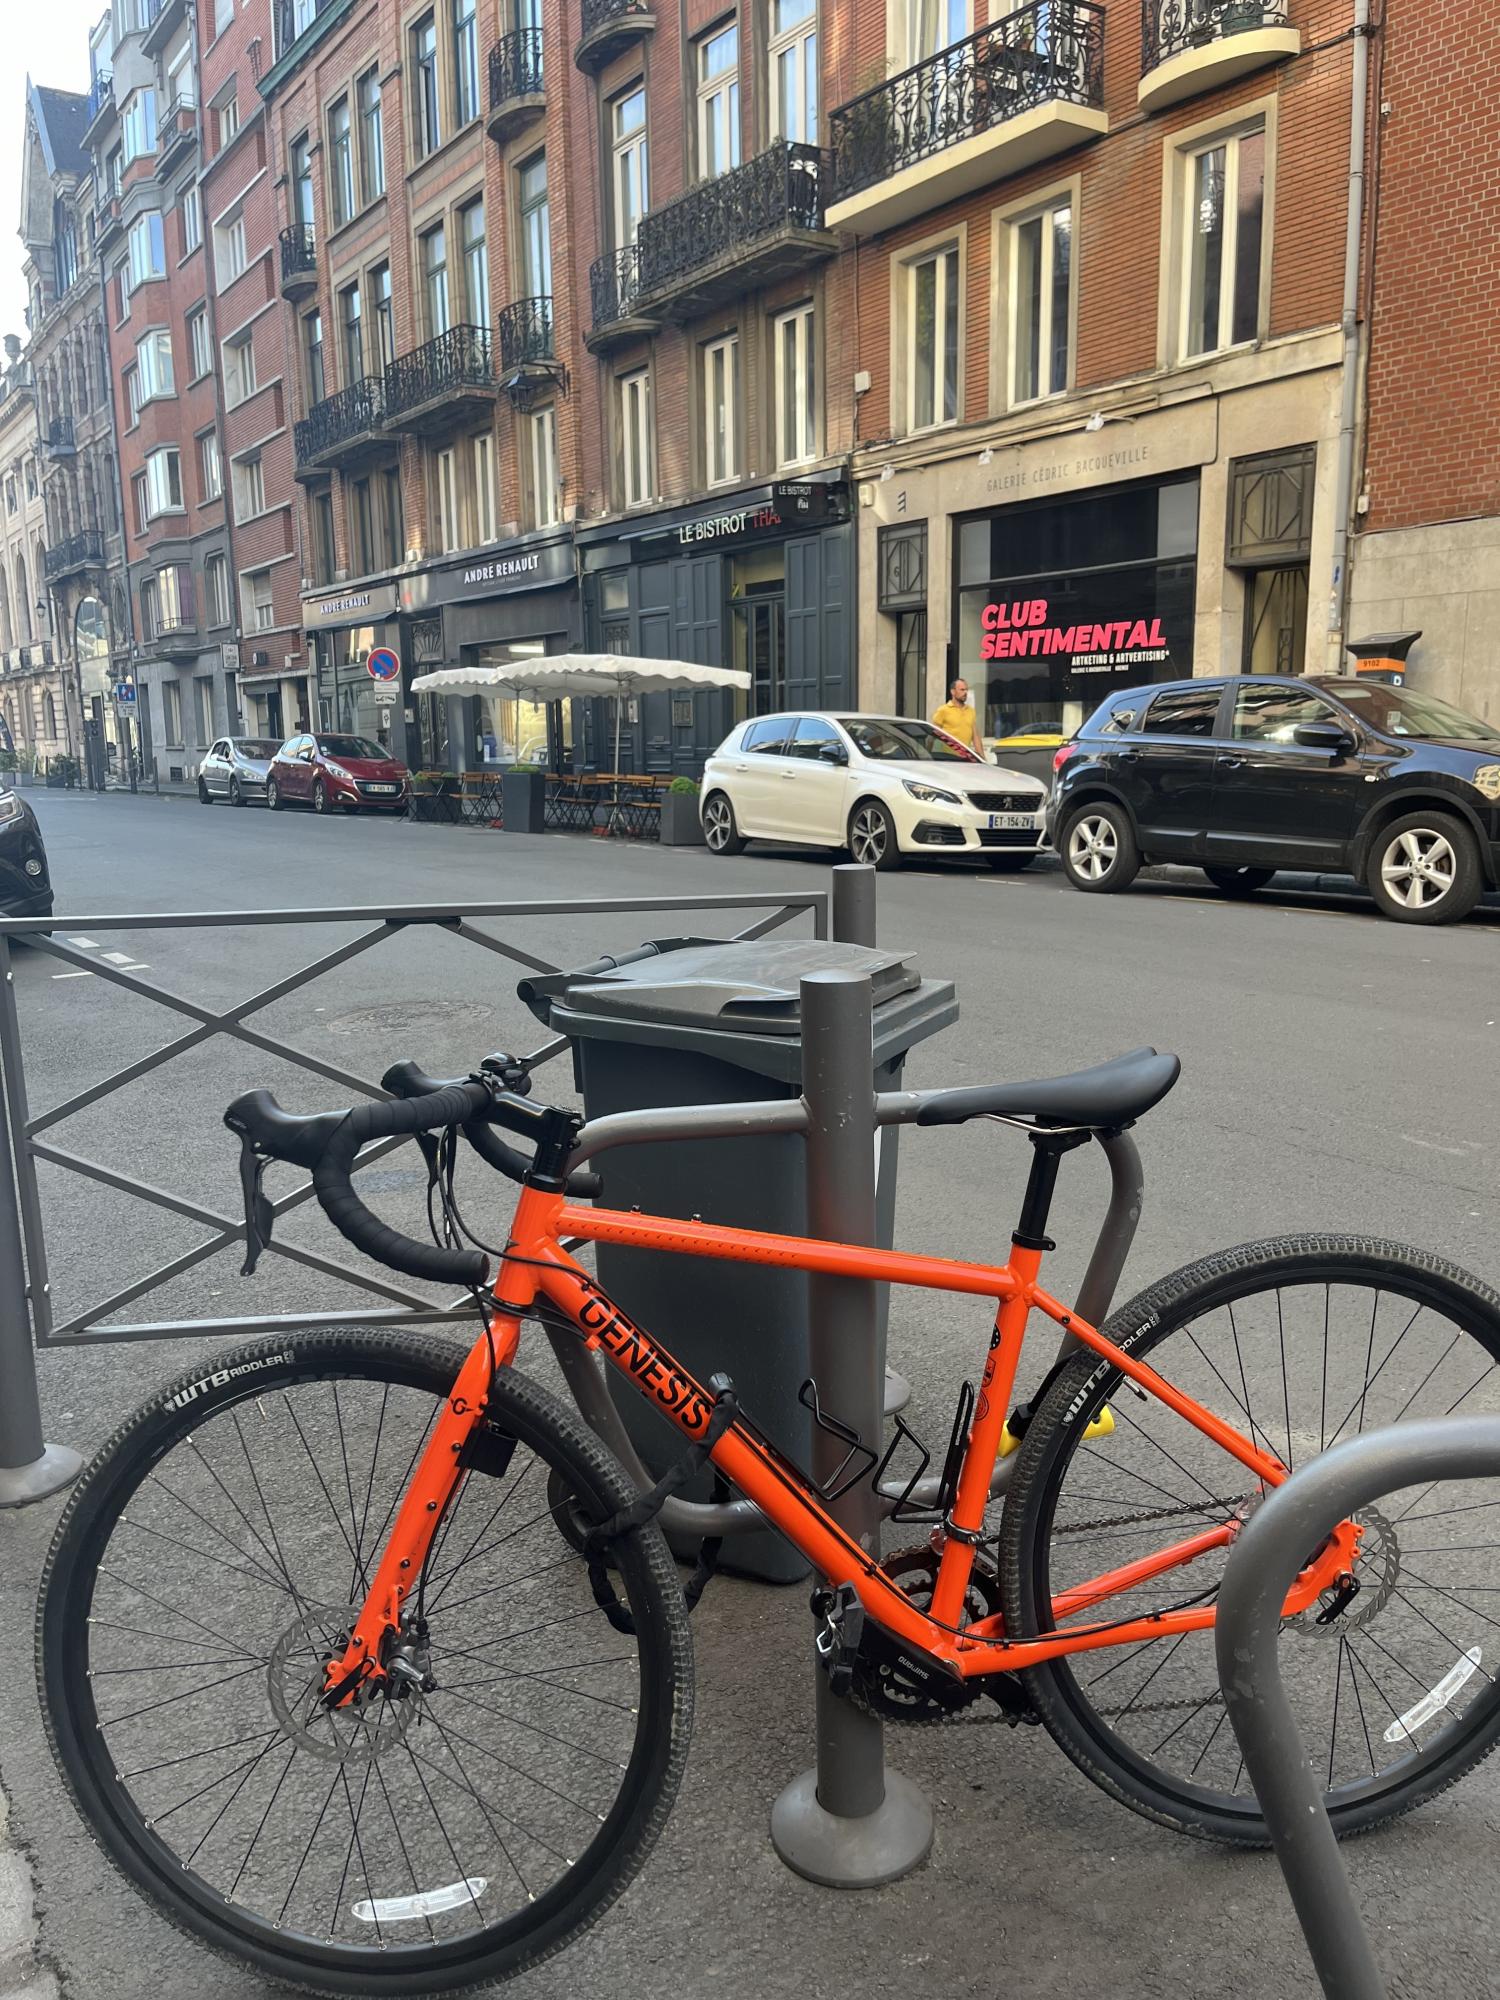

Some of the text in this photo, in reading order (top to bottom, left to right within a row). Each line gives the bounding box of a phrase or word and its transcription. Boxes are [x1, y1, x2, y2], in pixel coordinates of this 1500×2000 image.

[986, 446, 1149, 492] GALERIE CÉDRIC BACQUEVILLE
[778, 485, 787, 495] LE
[679, 524, 694, 544] LE
[696, 512, 747, 541] BISTROT
[464, 562, 495, 584] ANDRÉ
[496, 555, 539, 577] RENAULT
[980, 599, 1048, 630] CLUB
[978, 618, 1167, 660] SENTIMENTAL
[1071, 654, 1108, 666] ARTKETING
[579, 1296, 711, 1429] GENESIS
[173, 1369, 231, 1408] WTB
[229, 1355, 284, 1378] RIDDLER
[898, 1655, 930, 1680] SHIMANO
